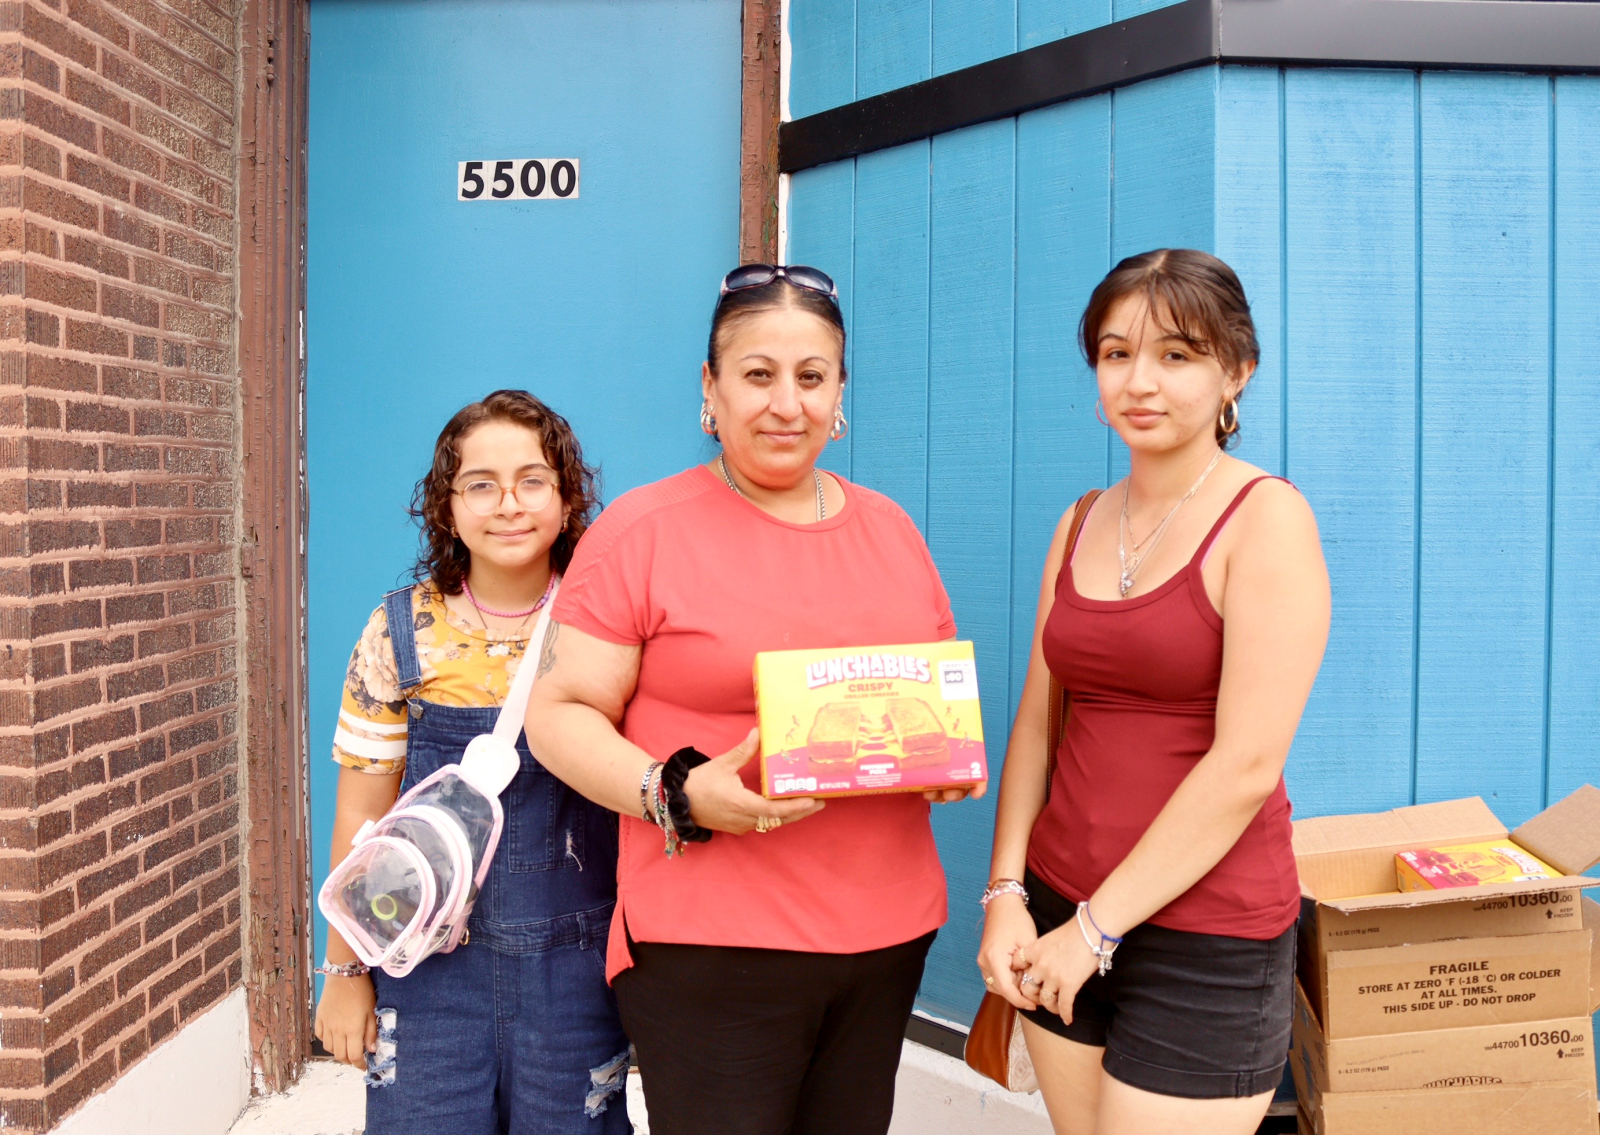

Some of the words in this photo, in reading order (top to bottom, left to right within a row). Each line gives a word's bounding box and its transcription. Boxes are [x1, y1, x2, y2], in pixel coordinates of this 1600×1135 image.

[461, 160, 576, 199] 5500
[806, 653, 932, 690] LUNCHABLES
[848, 682, 893, 693] CRISPY
[970, 761, 982, 775] 2
[1429, 961, 1489, 976] FRAGILE
[1358, 983, 1394, 995] STORE
[1396, 982, 1411, 992] AT
[1413, 979, 1442, 990] ZERO
[1458, 975, 1479, 986] (-18
[1500, 973, 1516, 982] OR
[1518, 969, 1561, 981] COLDER
[1420, 990, 1436, 1000] AT
[1438, 988, 1458, 999] ALL
[1460, 985, 1498, 996] TIMES.
[1383, 1004, 1408, 1015] THIS
[1410, 1001, 1436, 1012] SIDE
[1438, 1000, 1454, 1010] UP
[1463, 997, 1479, 1007] DO
[1481, 995, 1503, 1006] NOT
[1506, 992, 1537, 1004] DROP
